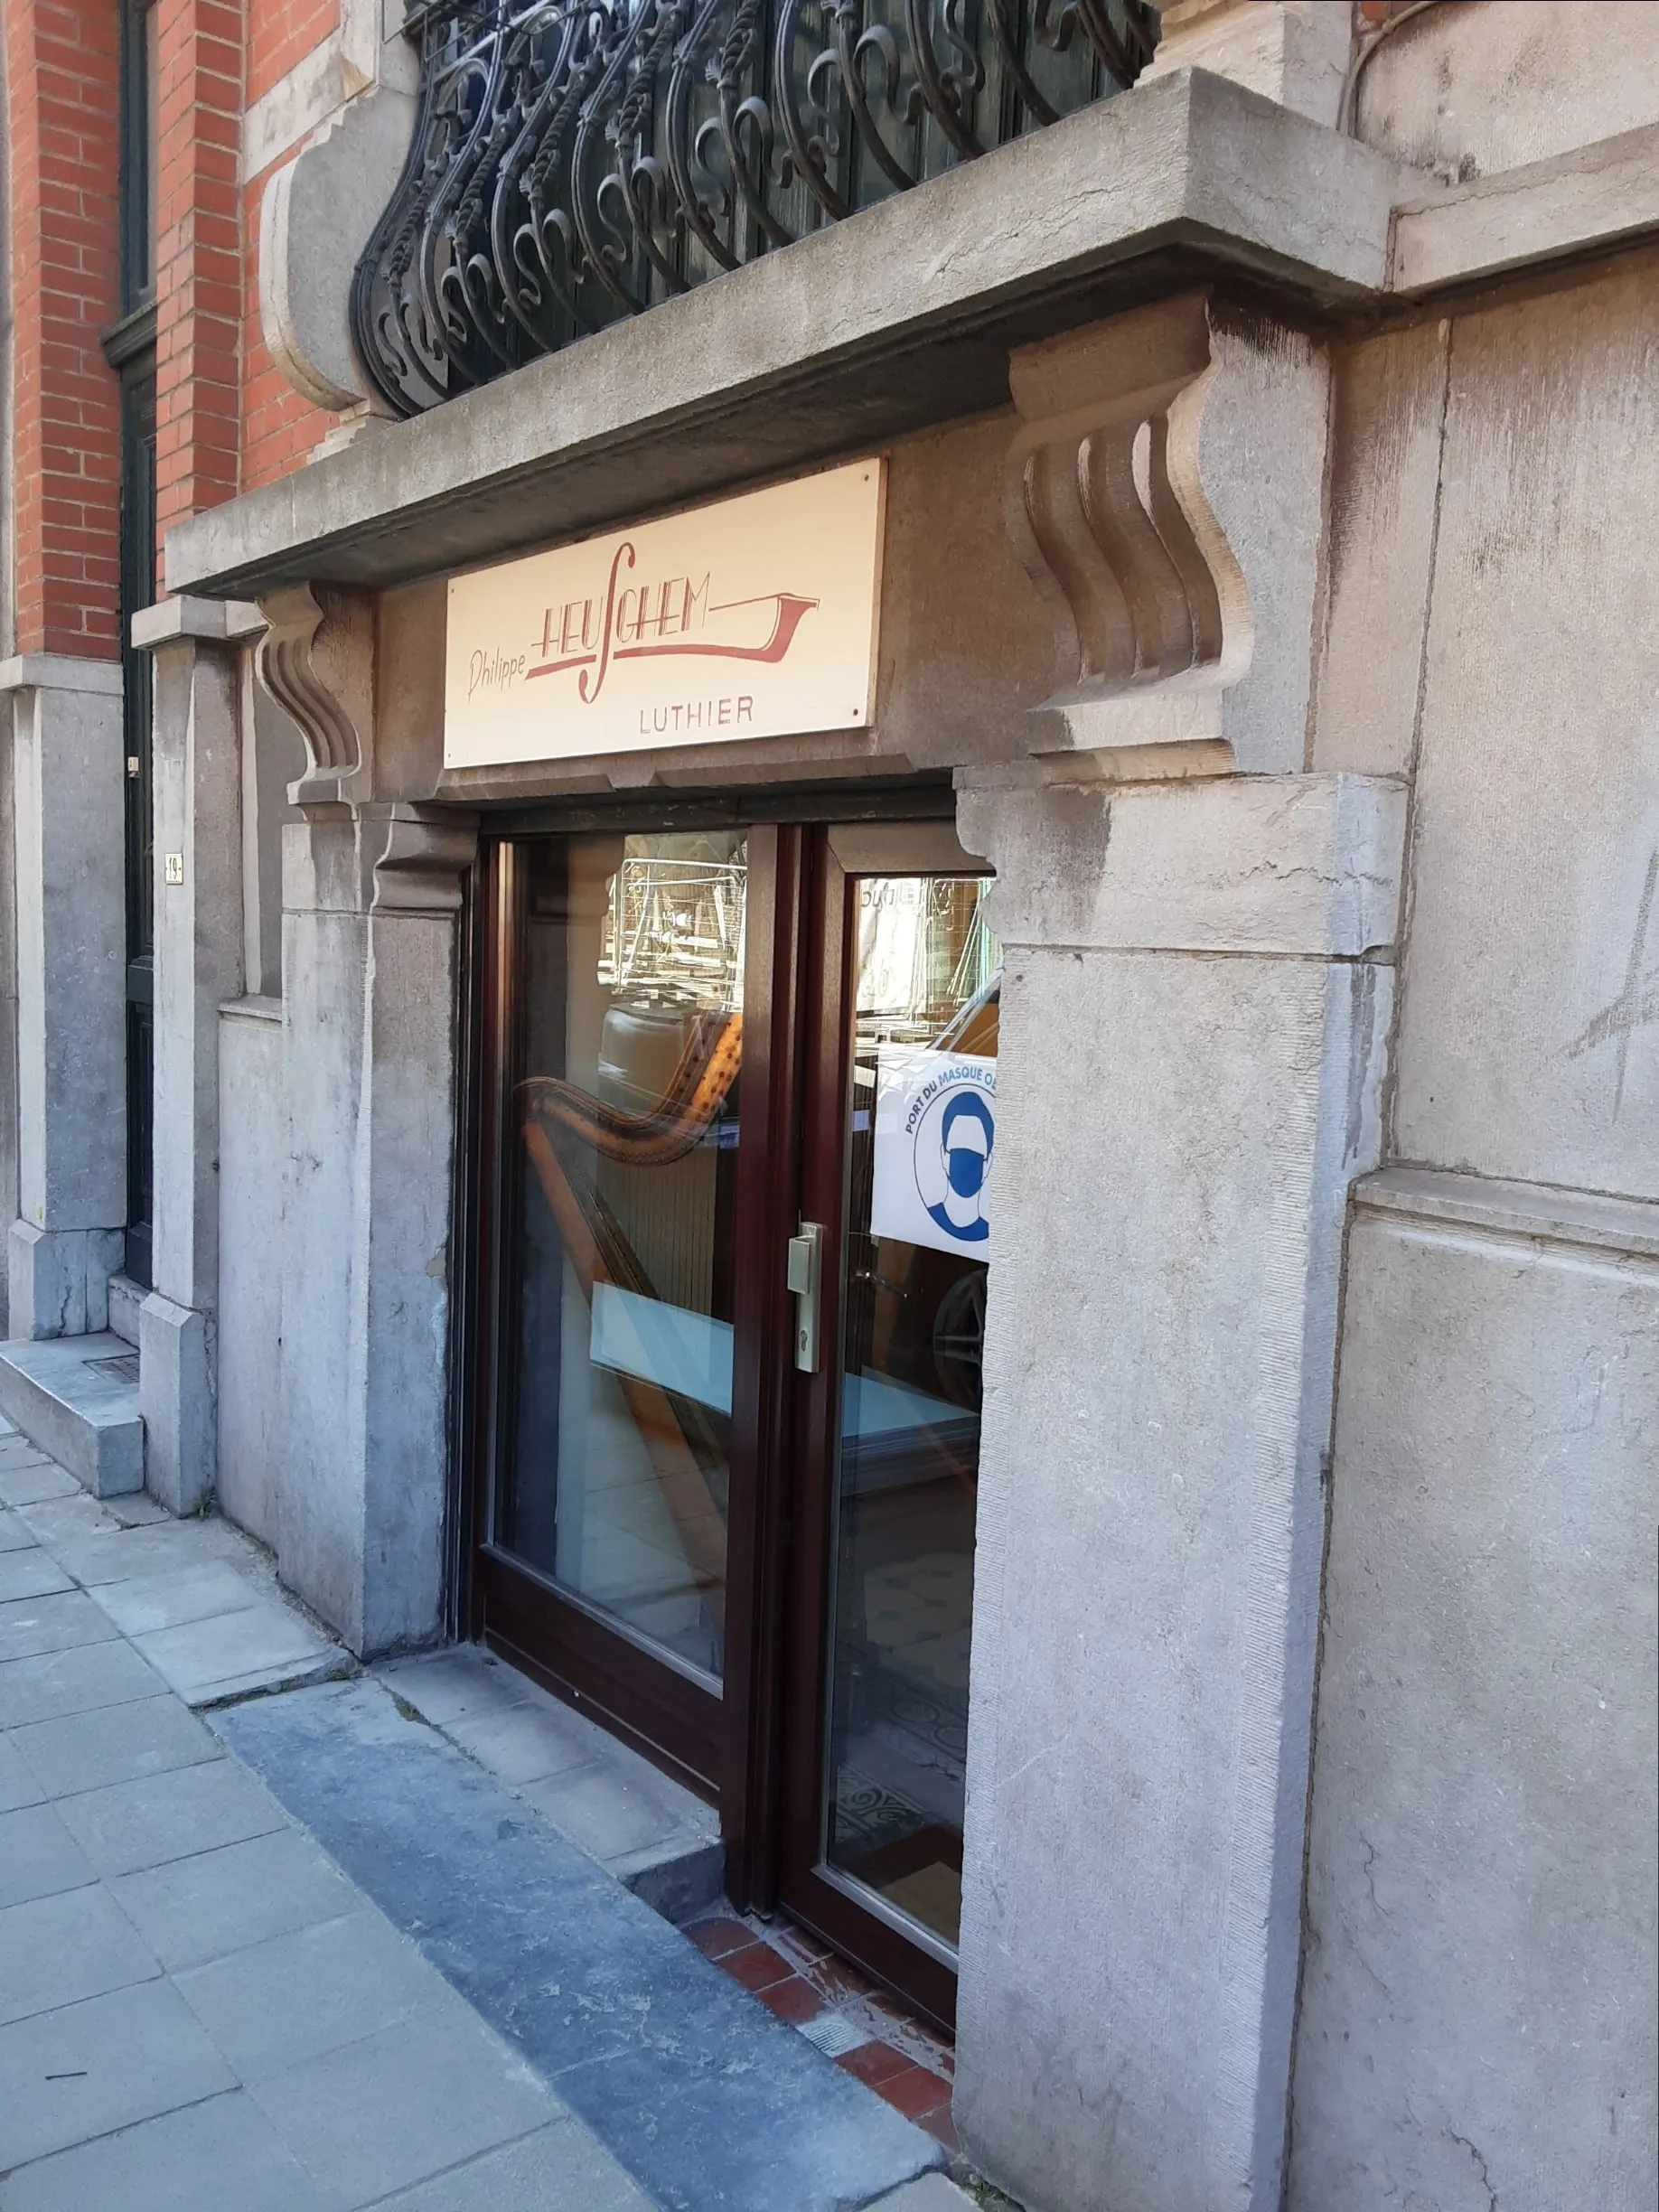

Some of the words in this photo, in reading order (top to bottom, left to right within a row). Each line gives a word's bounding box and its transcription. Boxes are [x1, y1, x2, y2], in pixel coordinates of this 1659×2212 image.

[468, 647, 526, 703] Philippe
[640, 695, 754, 734] LUTHIER
[904, 1096, 924, 1135] PORT
[923, 1080, 938, 1100] DU
[938, 1066, 983, 1086] MASQUE
